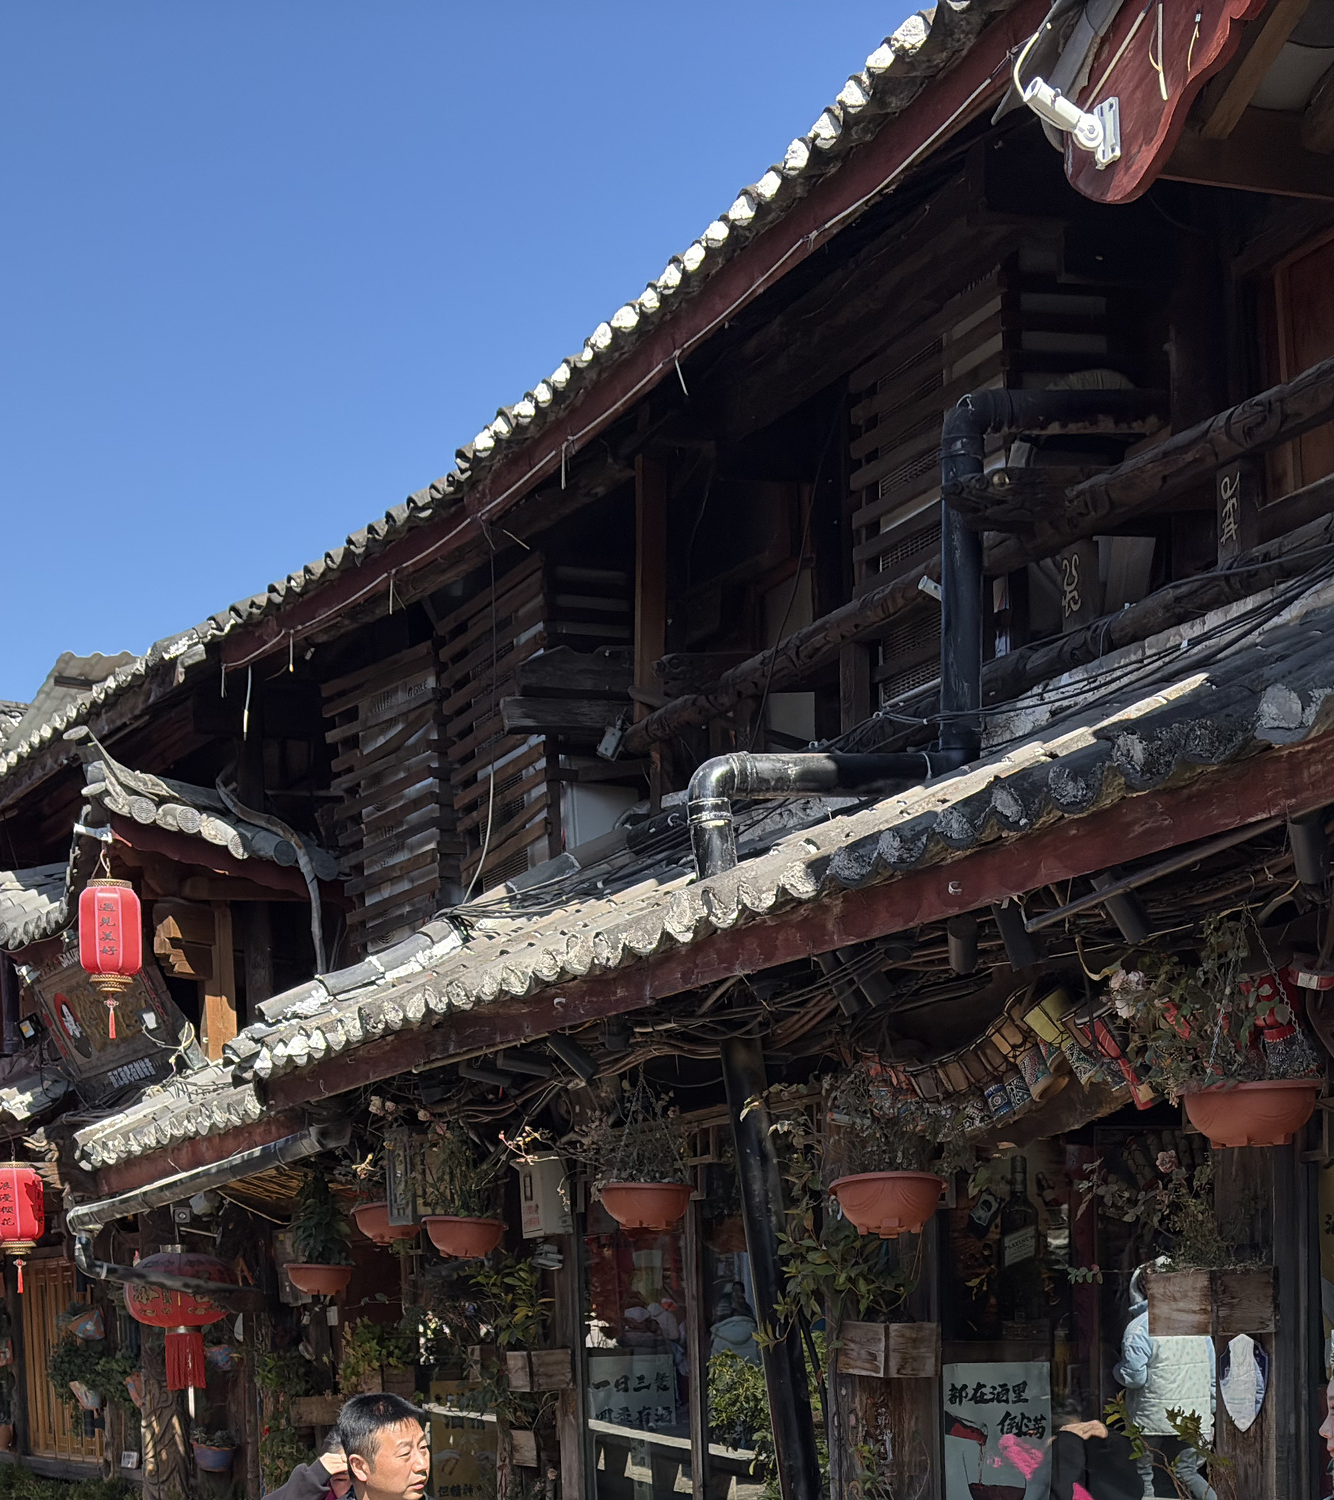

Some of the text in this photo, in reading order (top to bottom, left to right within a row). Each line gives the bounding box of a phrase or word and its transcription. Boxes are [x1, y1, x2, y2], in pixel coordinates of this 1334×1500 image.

[99, 902, 118, 956] 遇见美好
[948, 1380, 1029, 1407] 都在酒里
[996, 1410, 1047, 1440] 倒满
